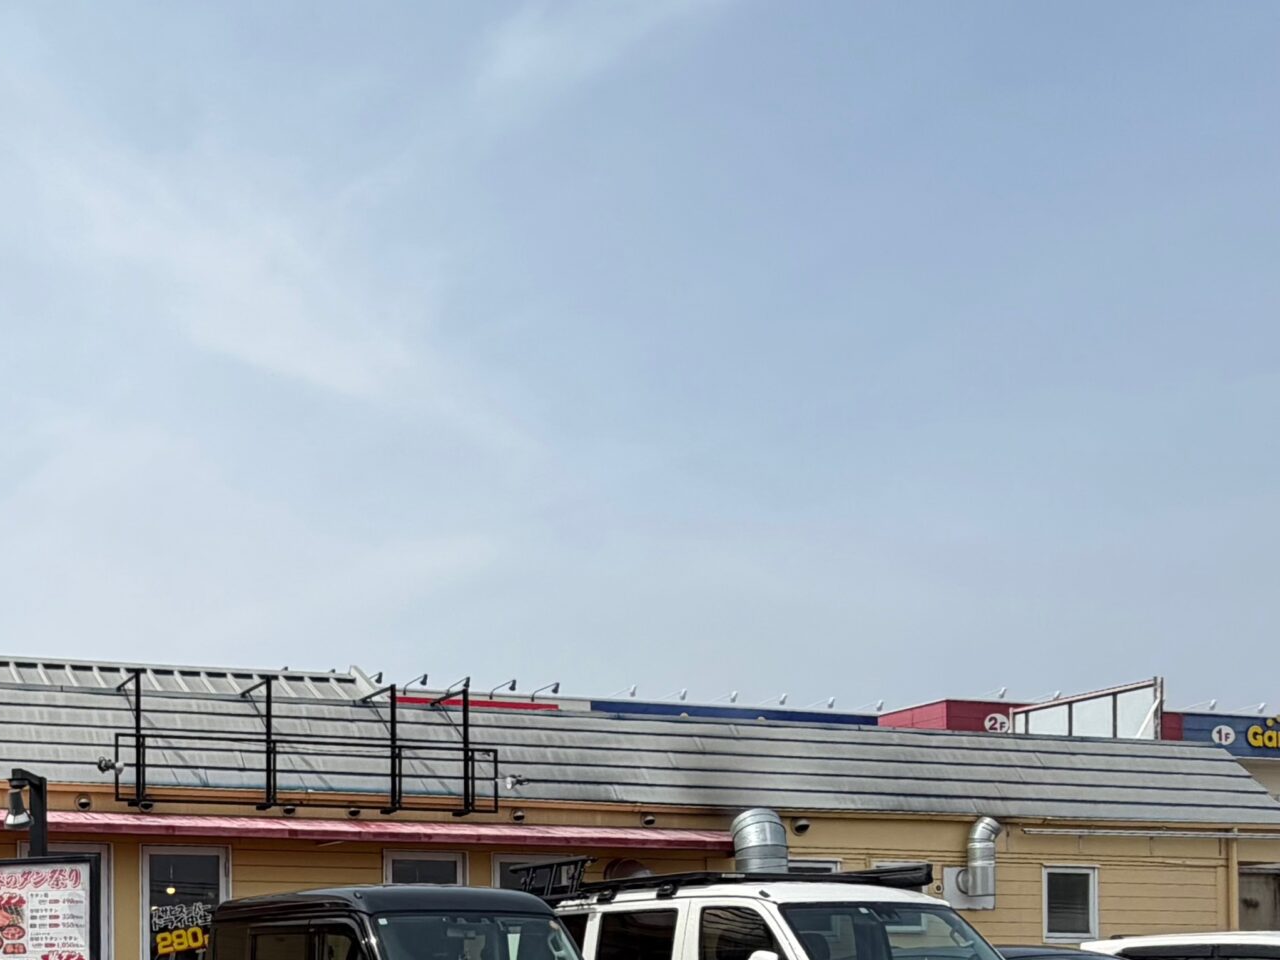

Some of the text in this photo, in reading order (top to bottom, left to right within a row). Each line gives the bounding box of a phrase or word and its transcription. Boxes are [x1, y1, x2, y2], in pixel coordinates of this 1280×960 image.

[987, 716, 1006, 732] 2F
[1216, 728, 1231, 742] 1F
[1247, 725, 1280, 748] Ga
